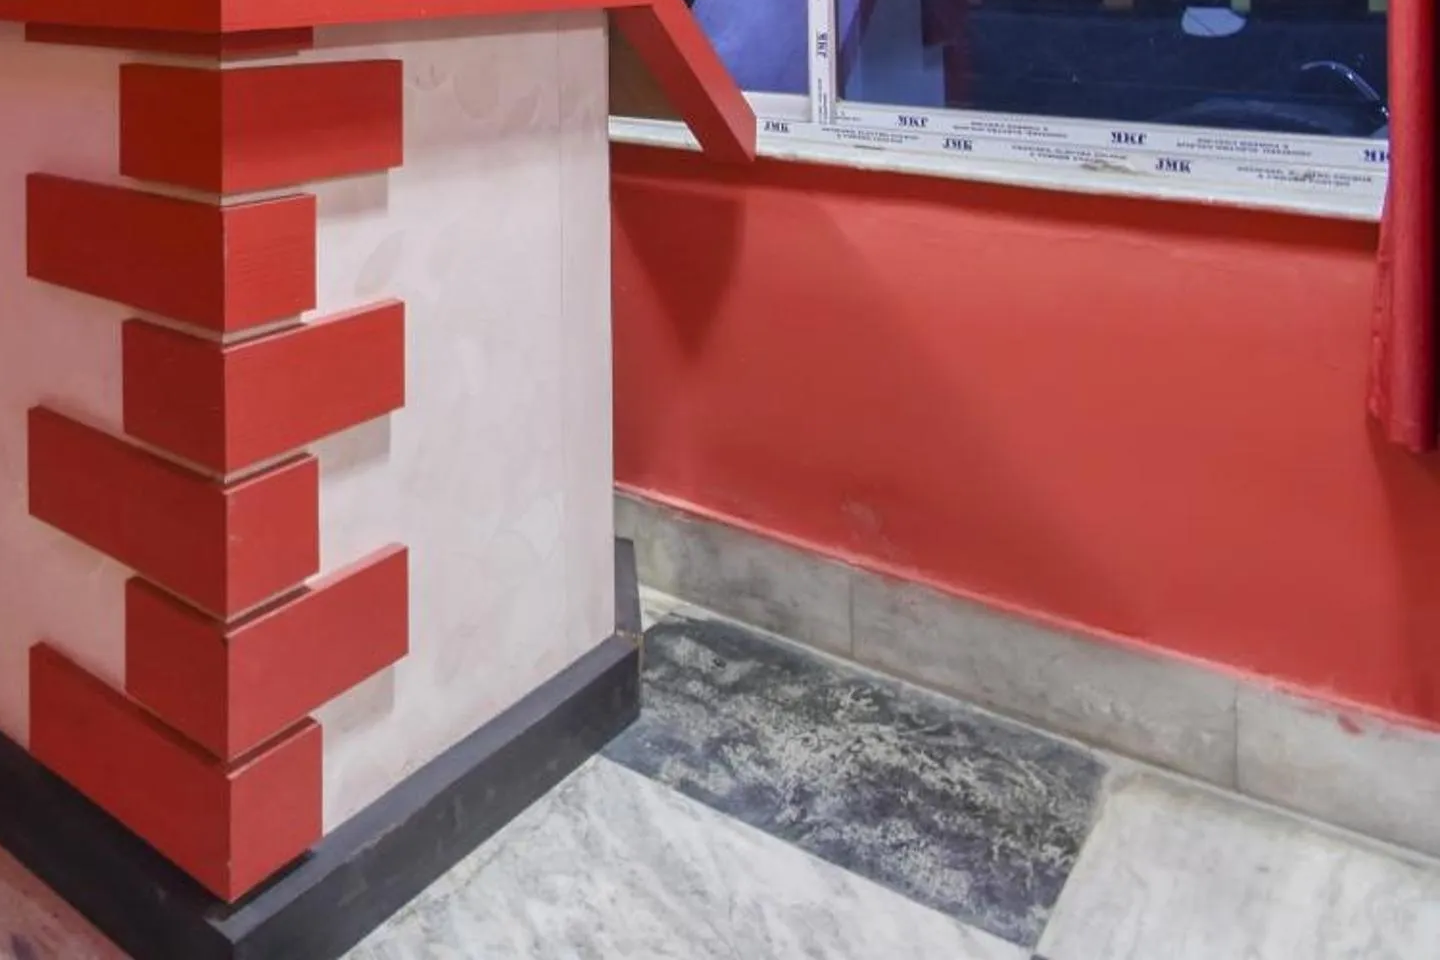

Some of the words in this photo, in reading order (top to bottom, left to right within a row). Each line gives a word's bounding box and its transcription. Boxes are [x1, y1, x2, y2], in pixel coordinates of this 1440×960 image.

[764, 120, 790, 133] JMK
[942, 138, 973, 151] JMK
[1154, 158, 1192, 174] JMK
